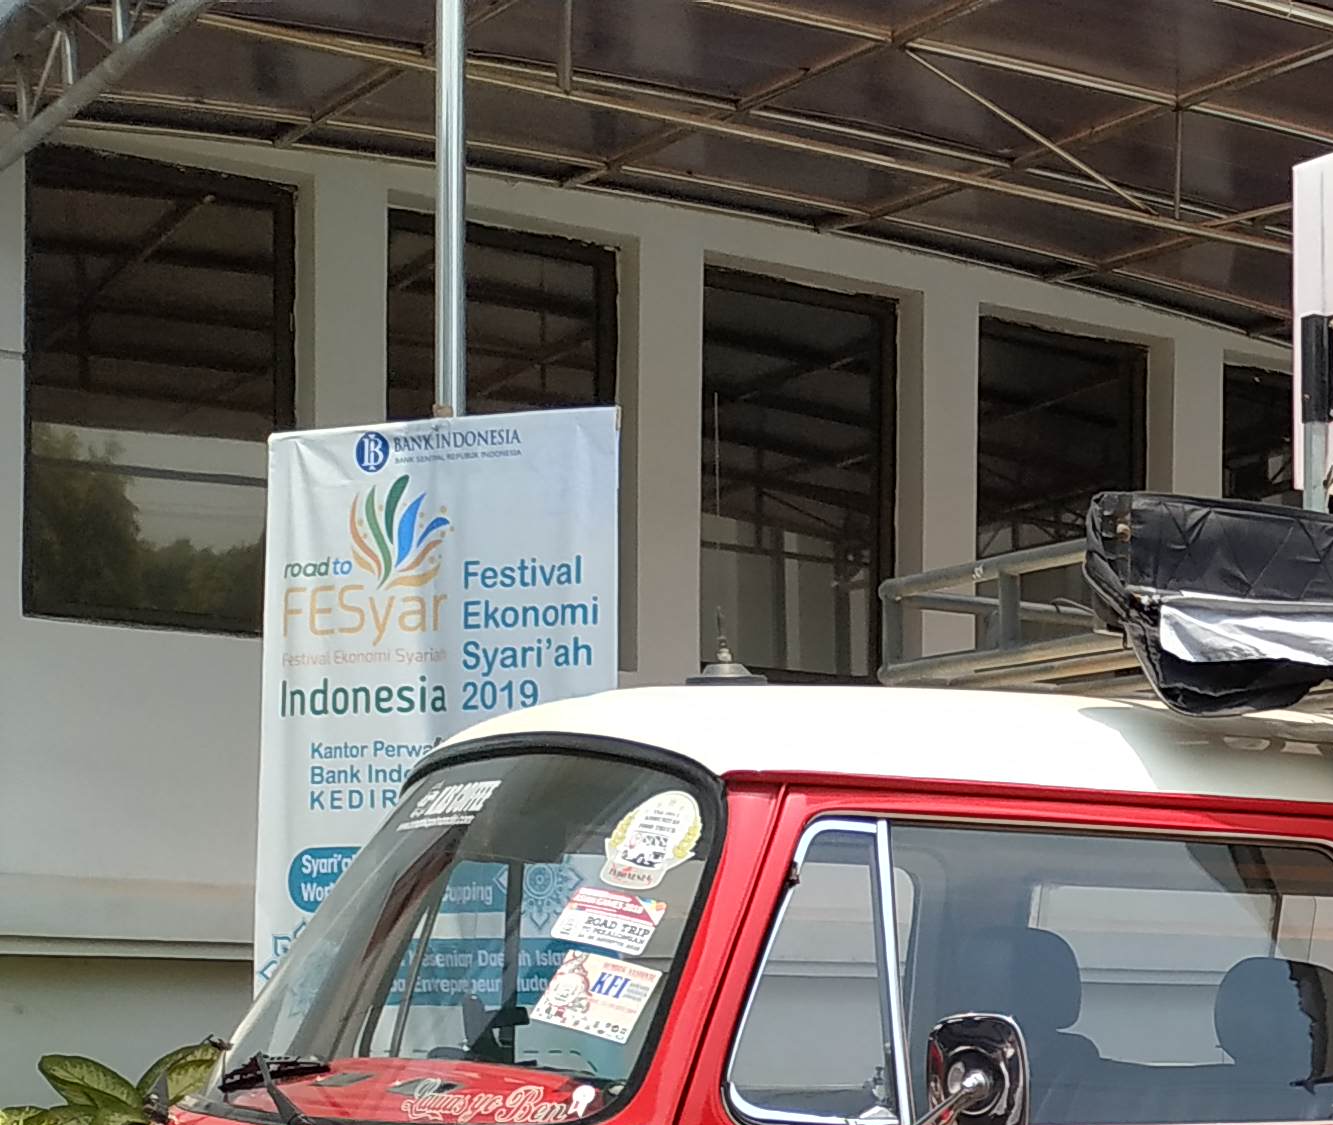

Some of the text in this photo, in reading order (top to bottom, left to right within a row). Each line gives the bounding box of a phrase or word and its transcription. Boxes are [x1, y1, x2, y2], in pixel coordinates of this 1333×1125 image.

[394, 428, 522, 452] BANK INDONESIA
[284, 557, 352, 579] road to
[463, 555, 582, 590] Festival
[281, 583, 448, 647] FESyar
[462, 596, 599, 630] Ekonomi
[282, 652, 332, 667] Festival
[334, 650, 391, 664] Ekonomi
[281, 675, 447, 718] Indonesia
[462, 679, 539, 711] 2019
[310, 737, 441, 759] Kantor Perwa
[310, 764, 361, 785] Bank
[310, 788, 398, 810] KEDIR
[301, 854, 355, 878] Syari'a
[301, 881, 335, 902] Wor
[536, 949, 568, 967] Isla
[591, 971, 632, 999] KFI
